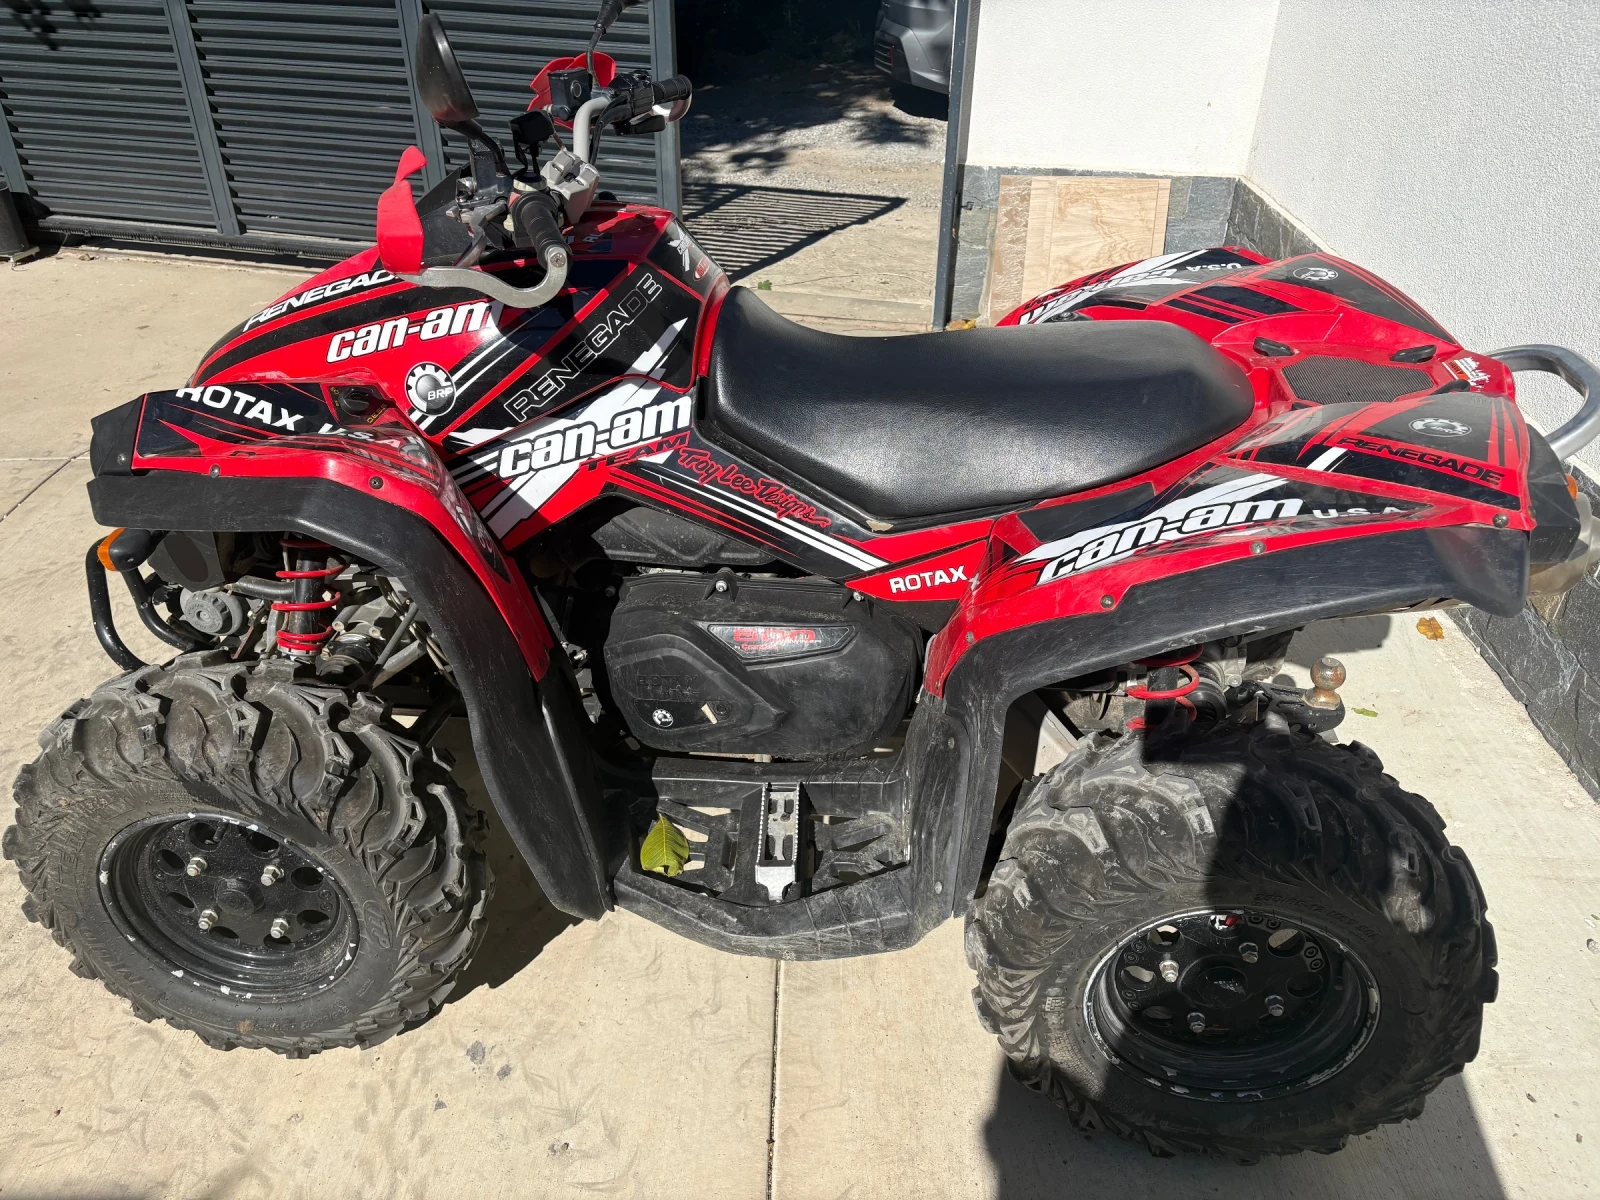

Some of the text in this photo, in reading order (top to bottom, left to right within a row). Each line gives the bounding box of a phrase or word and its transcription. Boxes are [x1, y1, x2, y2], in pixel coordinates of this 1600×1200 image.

[243, 269, 399, 332] RENEGAD
[326, 300, 493, 364] can-am
[503, 273, 663, 423] RENEGADE
[427, 387, 454, 401] BRP
[499, 396, 693, 479] can-am
[580, 431, 689, 471] TEAM
[1341, 436, 1505, 486] RENEGADE
[678, 447, 719, 486] Troy
[717, 464, 757, 495] Lee
[1036, 498, 1303, 586] can-am
[889, 566, 968, 593] ROTAX
